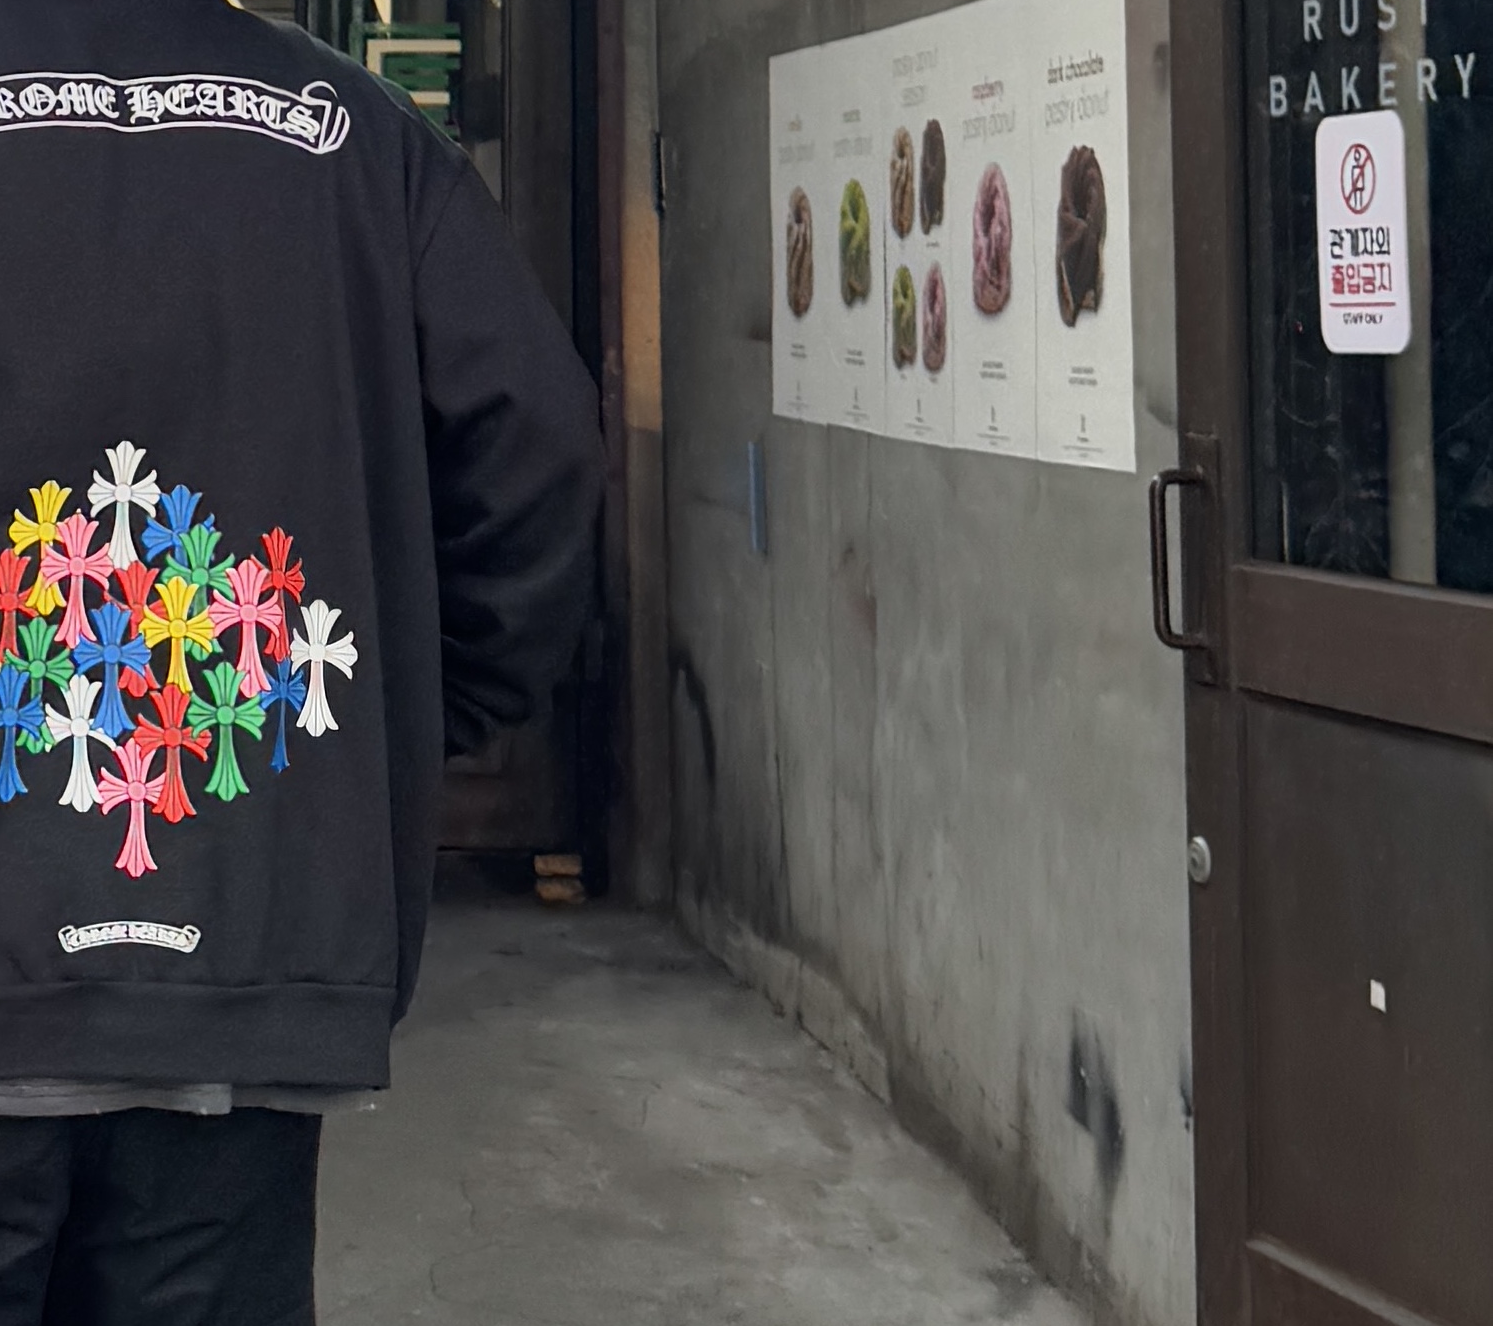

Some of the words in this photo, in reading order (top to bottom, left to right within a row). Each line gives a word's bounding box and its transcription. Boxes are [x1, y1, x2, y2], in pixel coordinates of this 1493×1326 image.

[124, 82, 322, 143] HEARTS
[1269, 52, 1476, 118] BAKERY
[1331, 262, 1393, 295] 출입금지
